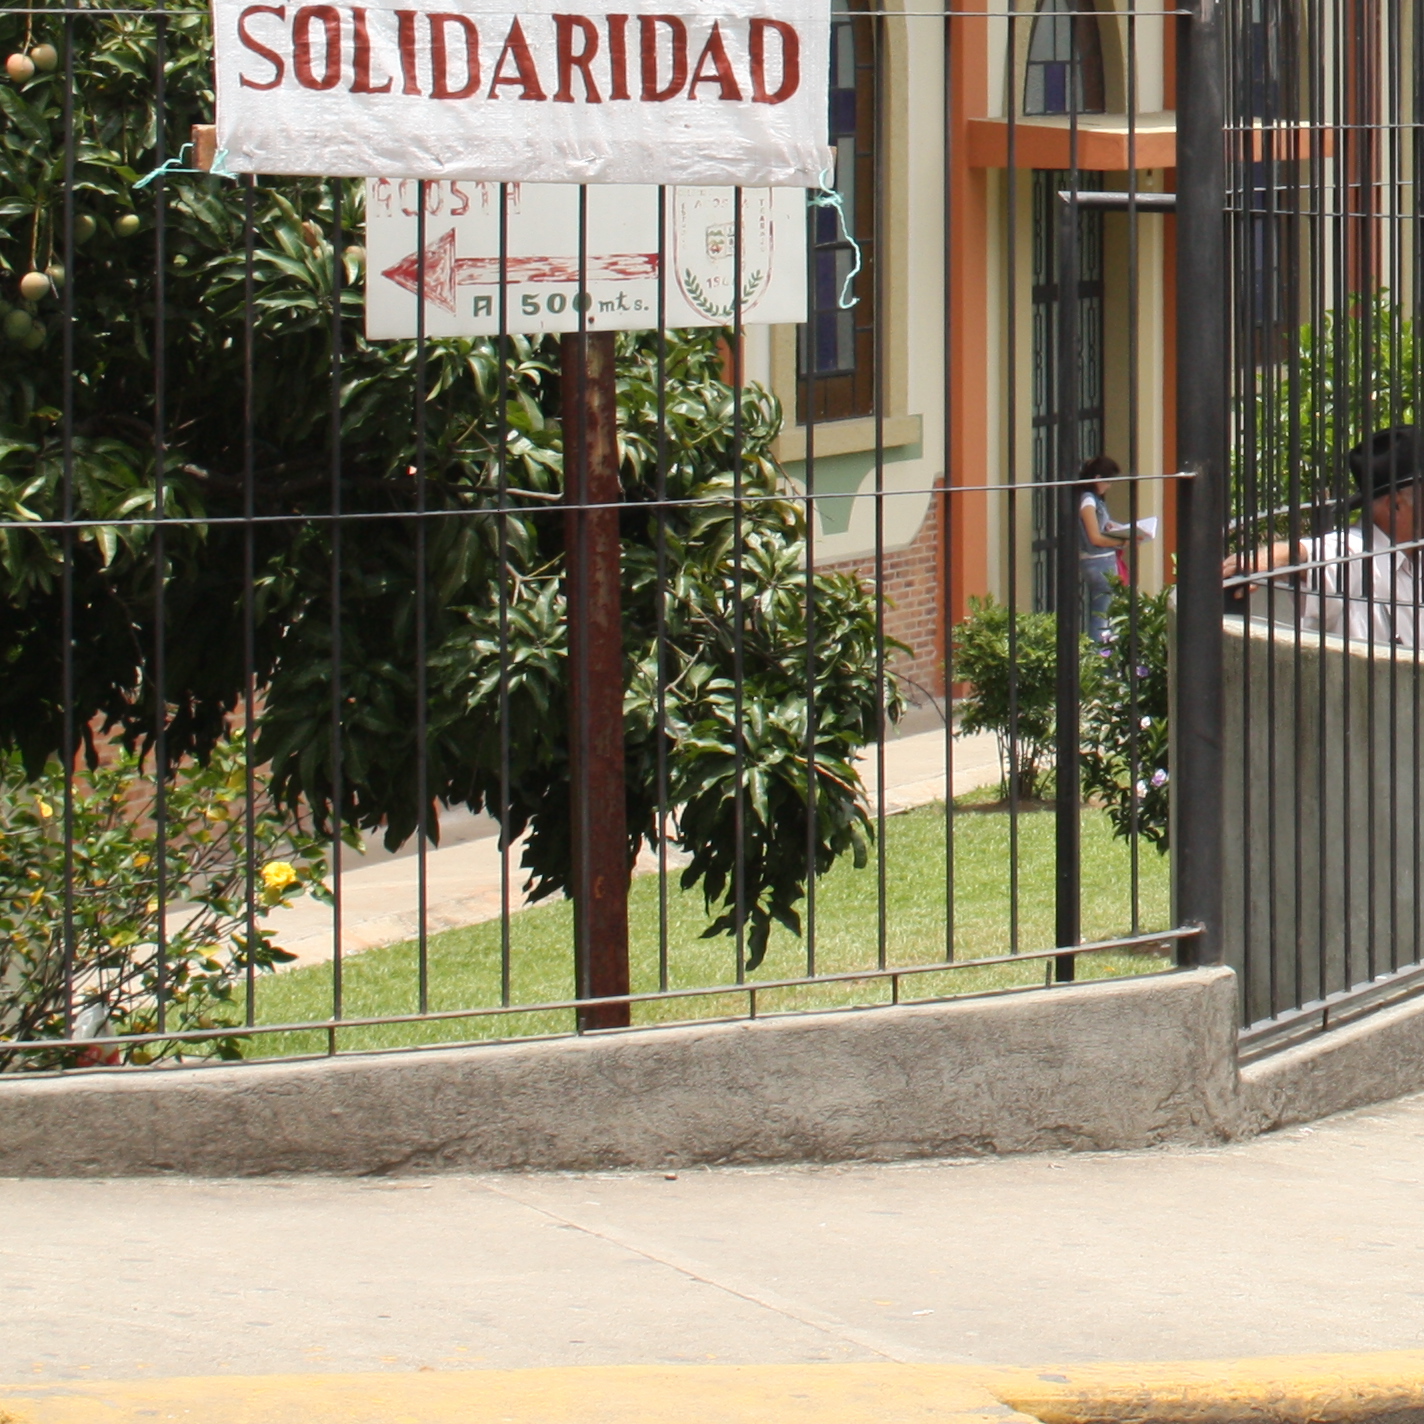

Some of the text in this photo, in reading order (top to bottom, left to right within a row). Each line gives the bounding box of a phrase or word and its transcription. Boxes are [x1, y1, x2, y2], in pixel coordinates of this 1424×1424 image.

[238, 4, 801, 106] SOLIDARIDAD
[473, 295, 493, 318] A
[521, 292, 593, 316] 500
